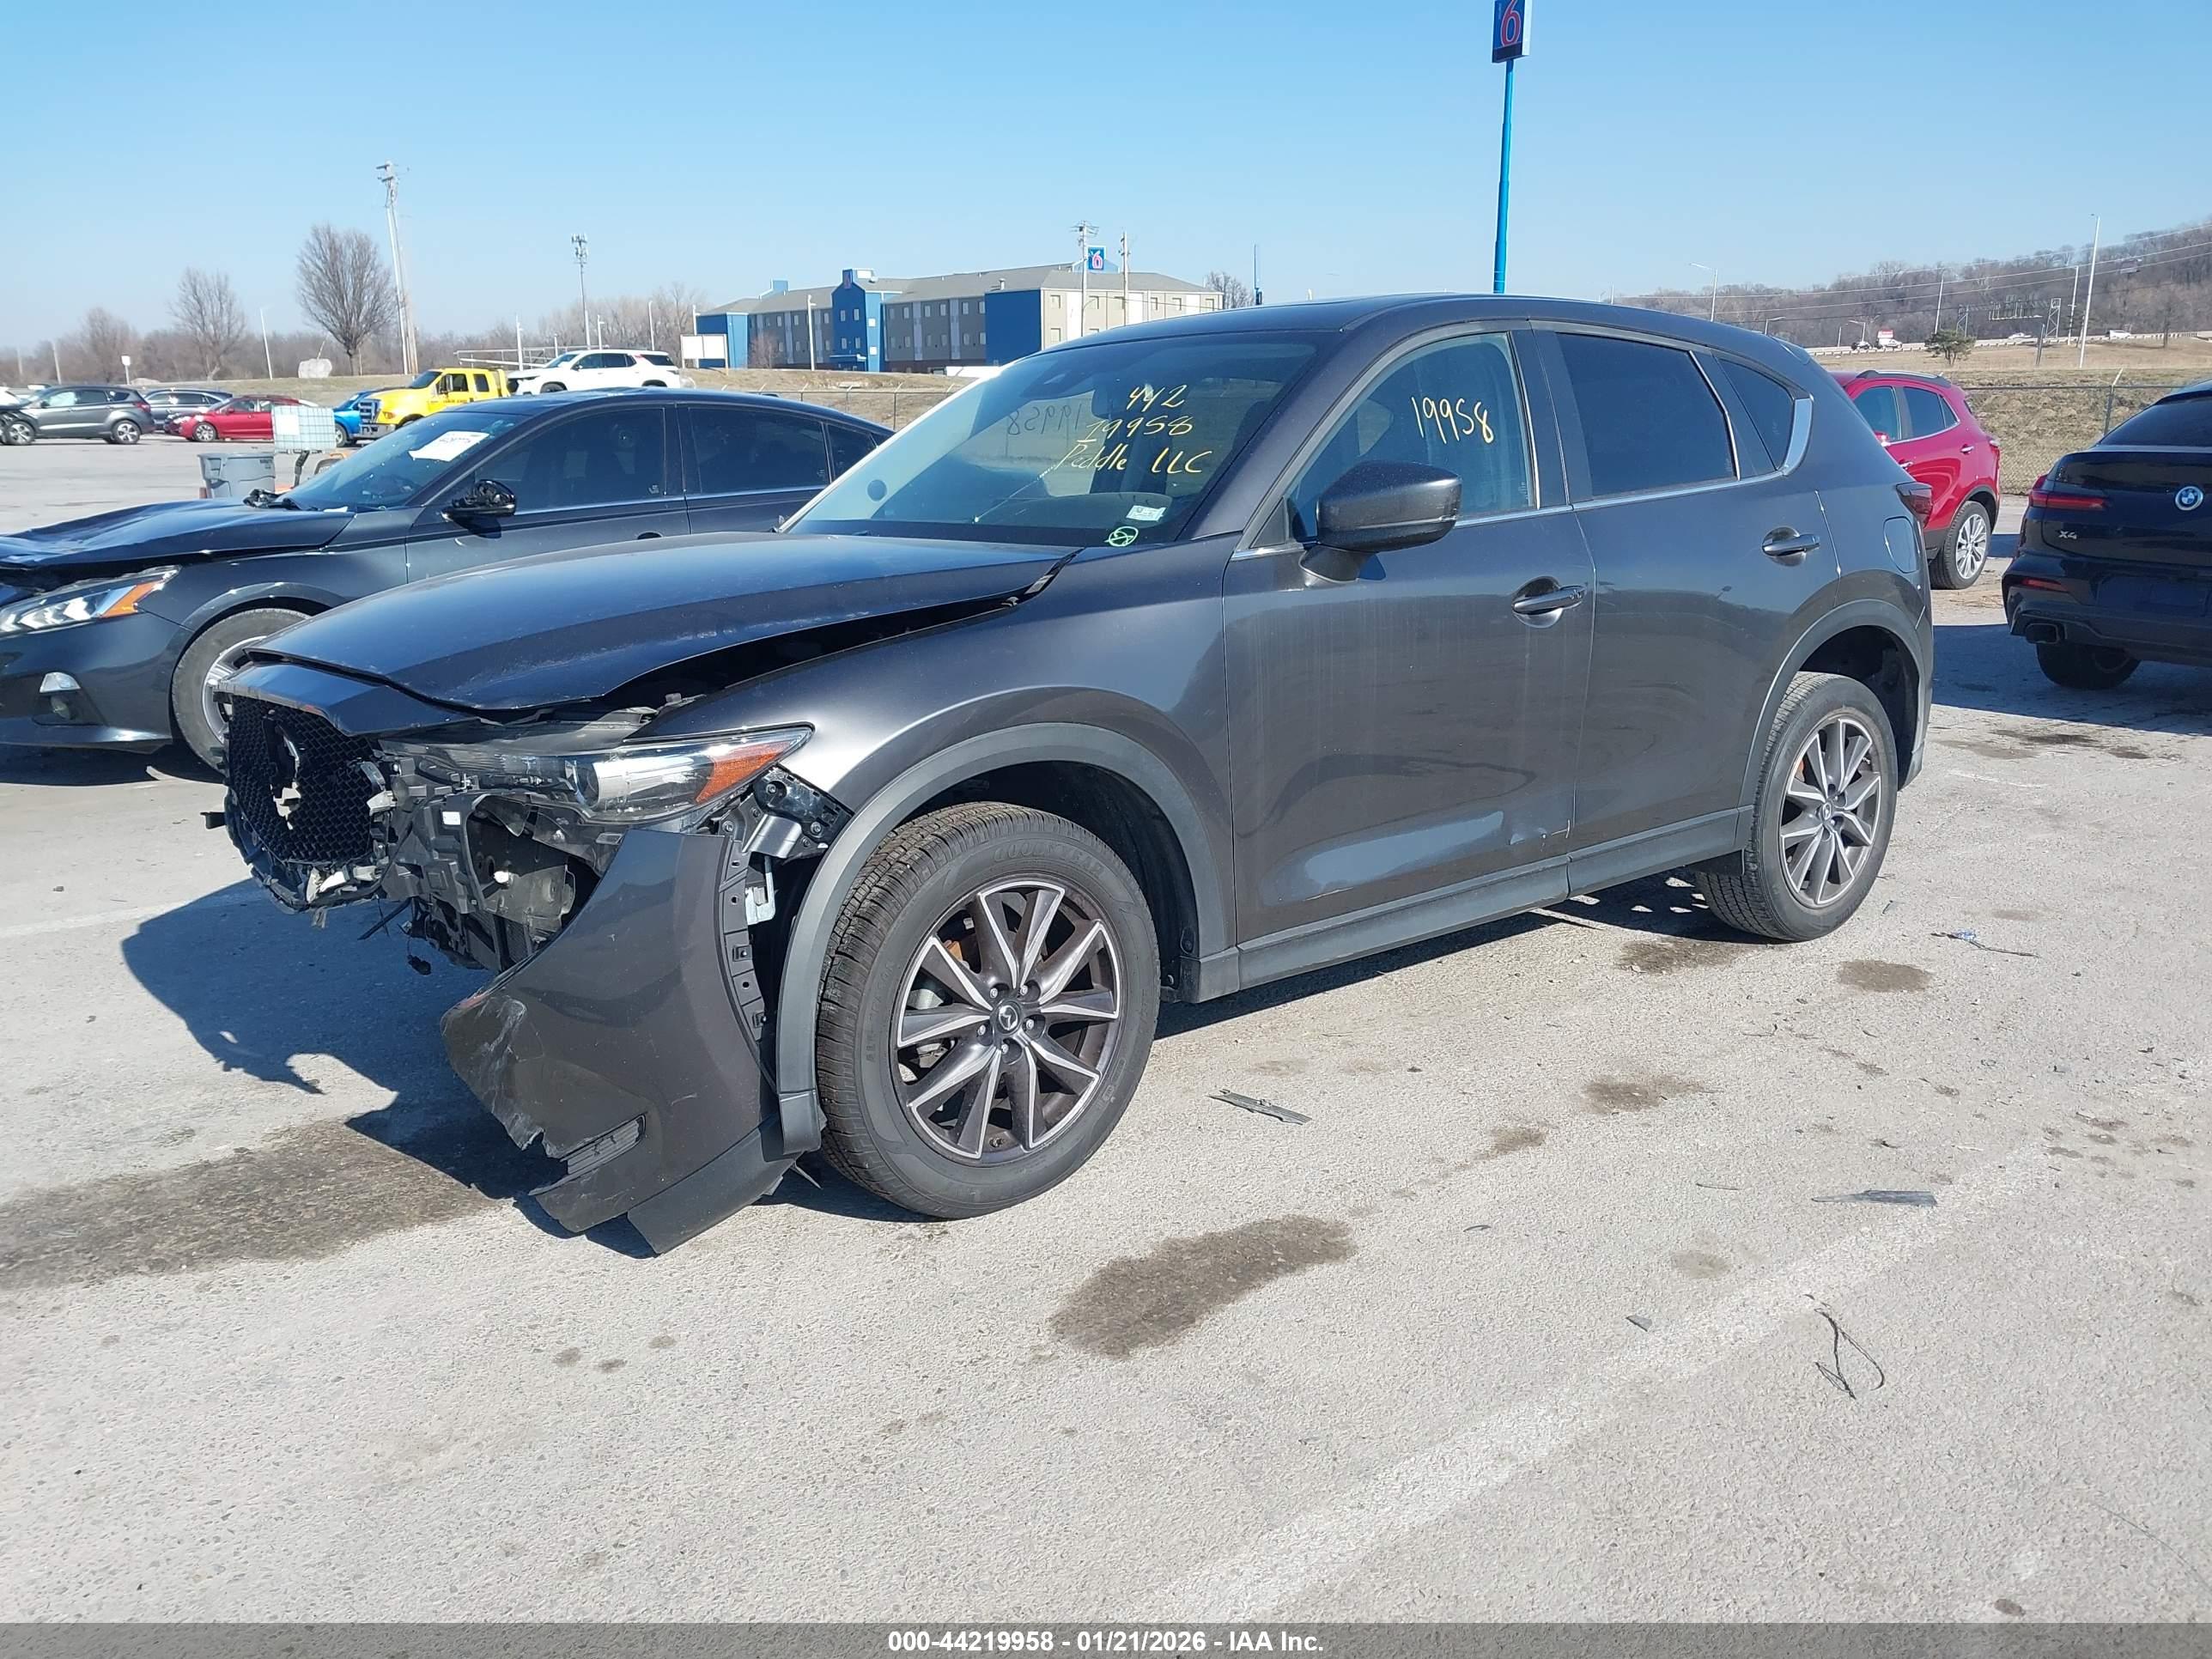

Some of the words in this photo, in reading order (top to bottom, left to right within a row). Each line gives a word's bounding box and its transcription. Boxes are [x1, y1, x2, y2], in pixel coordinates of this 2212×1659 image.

[1500, 0, 1522, 46] 6
[1091, 250, 1103, 269] 6
[1126, 384, 1188, 412] 442
[1076, 415, 1194, 443] 19958
[1410, 396, 1494, 444] 19958
[1151, 447, 1213, 474] LLC
[2058, 530, 2077, 539] X4
